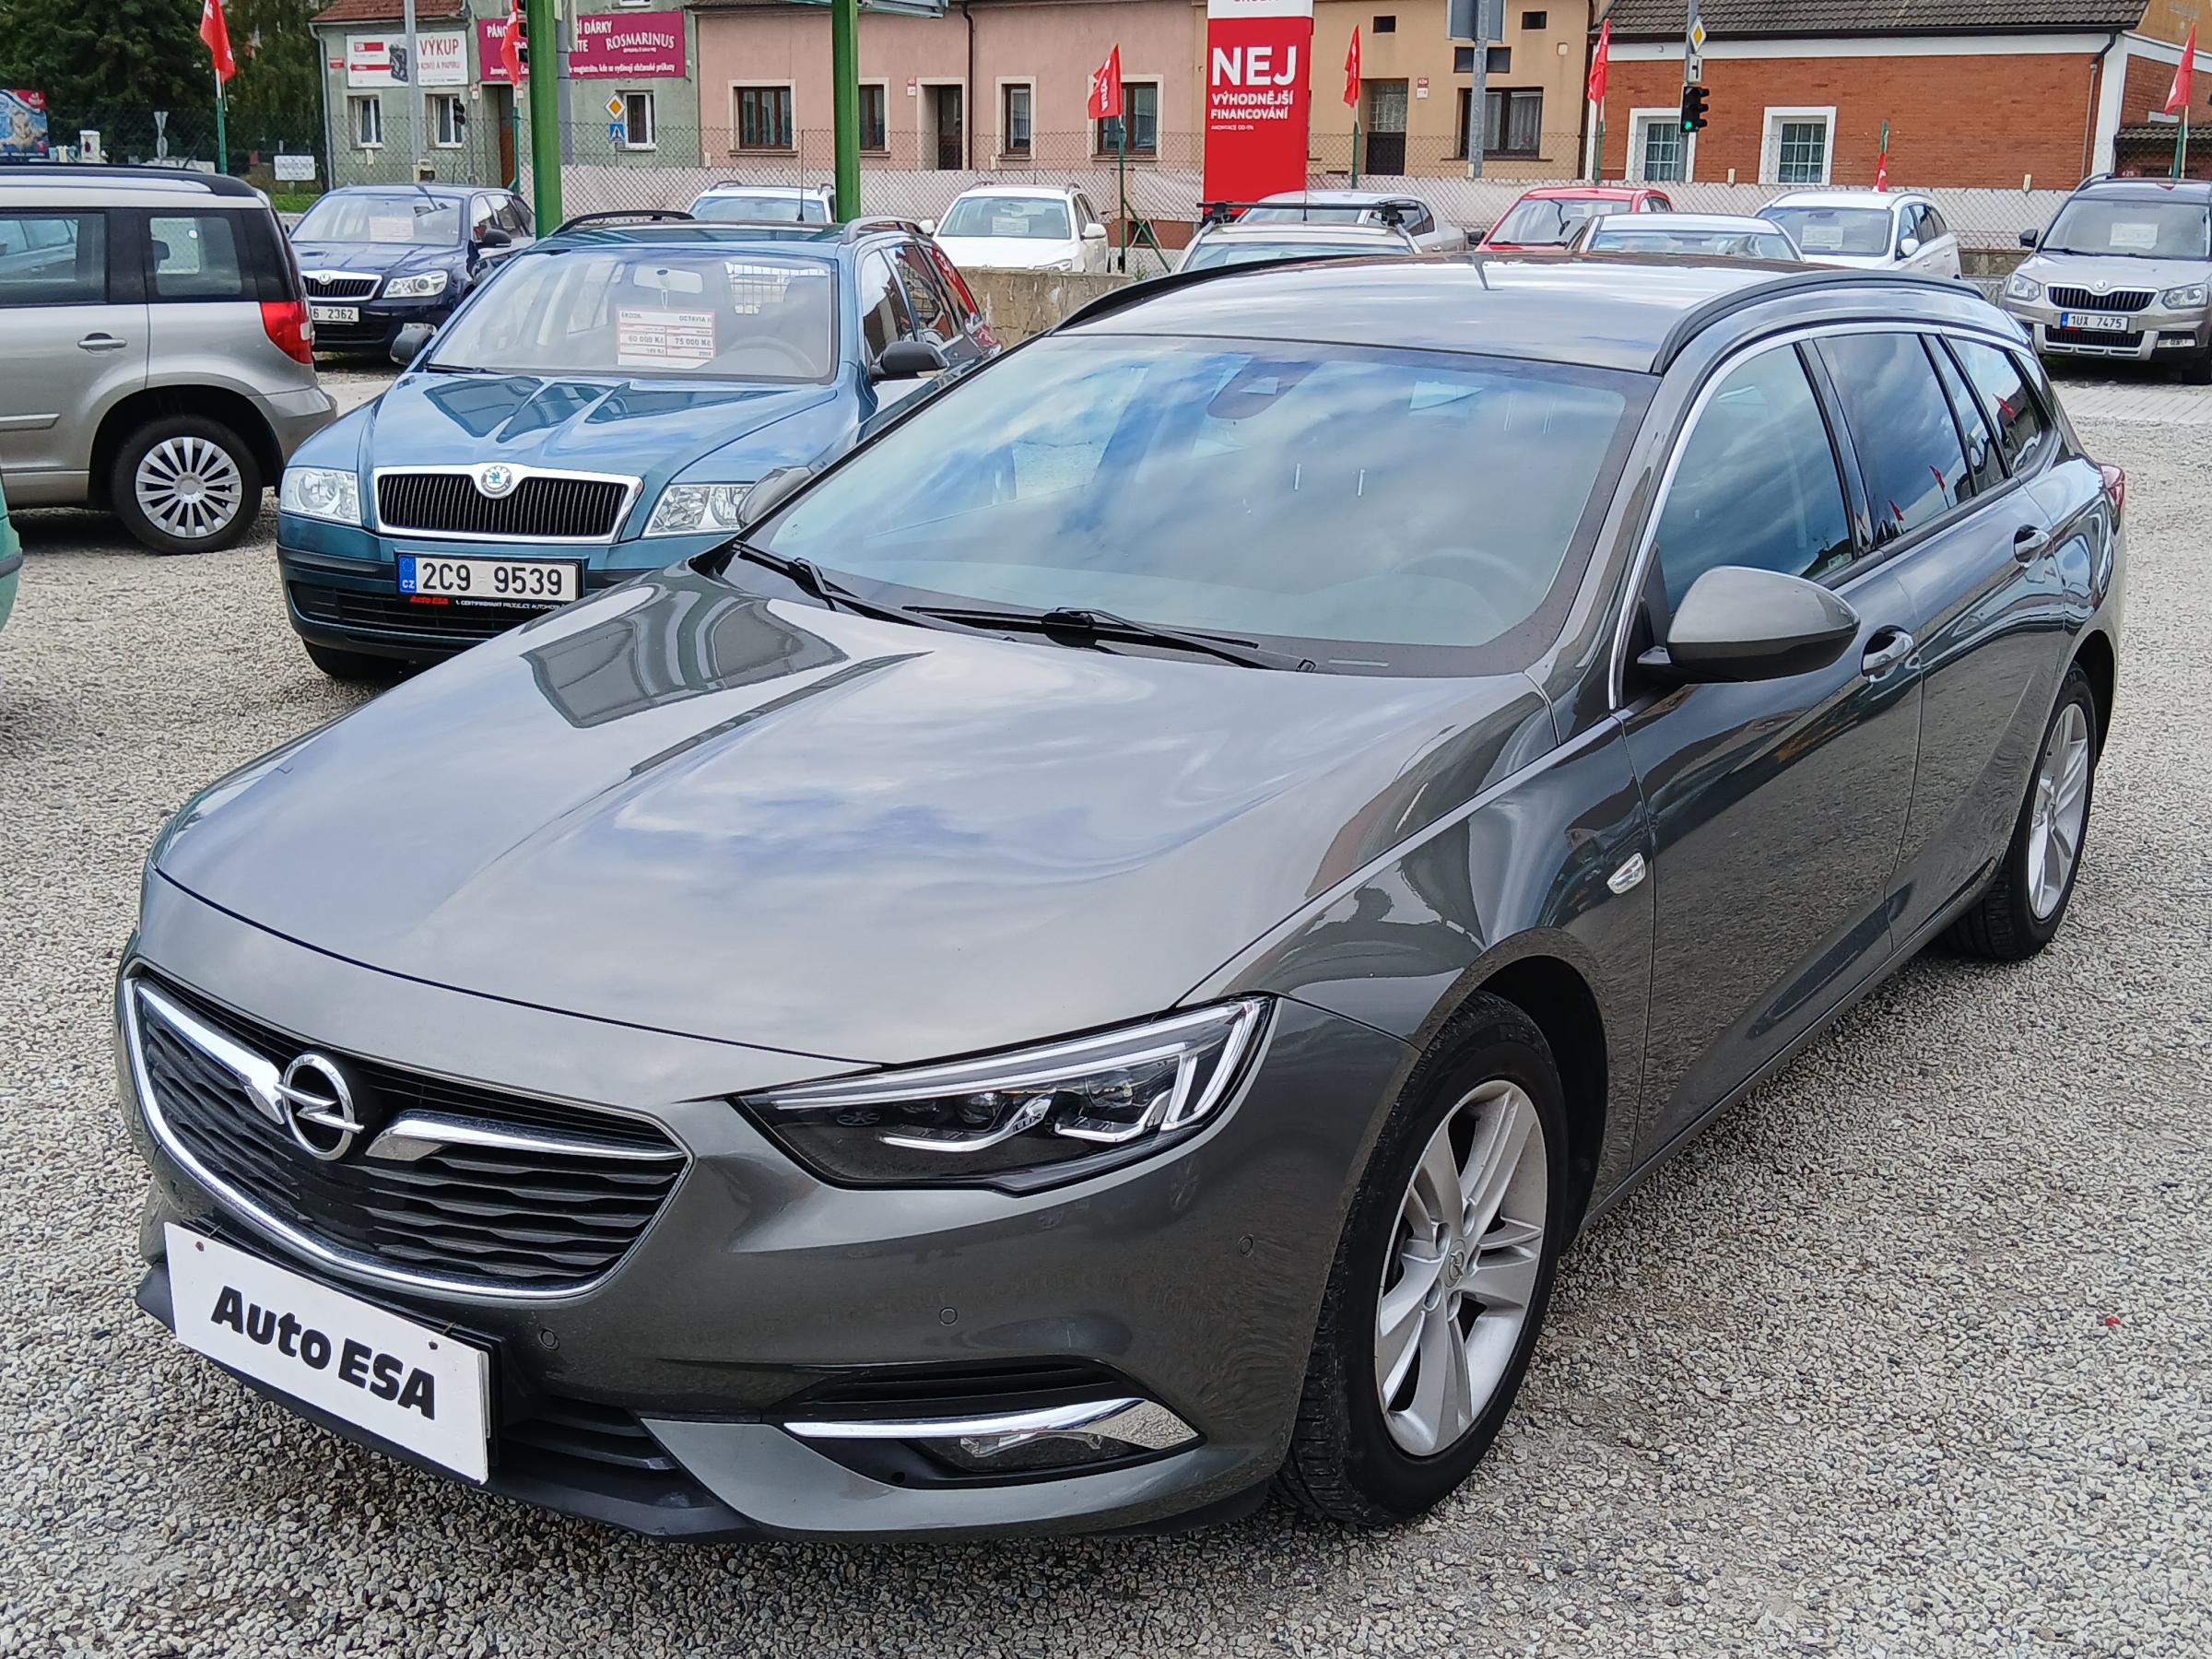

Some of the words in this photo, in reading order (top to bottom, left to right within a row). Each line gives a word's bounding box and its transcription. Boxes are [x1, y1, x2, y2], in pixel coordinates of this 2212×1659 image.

[584, 18, 613, 35] DÁRKY
[419, 36, 459, 56] VÝKUP
[606, 32, 675, 51] ROSMARINUS
[1212, 46, 1297, 86] NEJ
[1211, 89, 1294, 105] VÝHODNĚJŠÍ
[1210, 106, 1288, 120] FINANCOVÁNÍ
[327, 309, 354, 320] 2362
[2071, 315, 2088, 326] 1UX
[2097, 317, 2123, 328] 7475
[402, 580, 415, 589] CZ
[422, 562, 471, 592] 2C9
[493, 566, 562, 596] 9539
[210, 1285, 332, 1371] Auto
[338, 1337, 435, 1421] ESA
